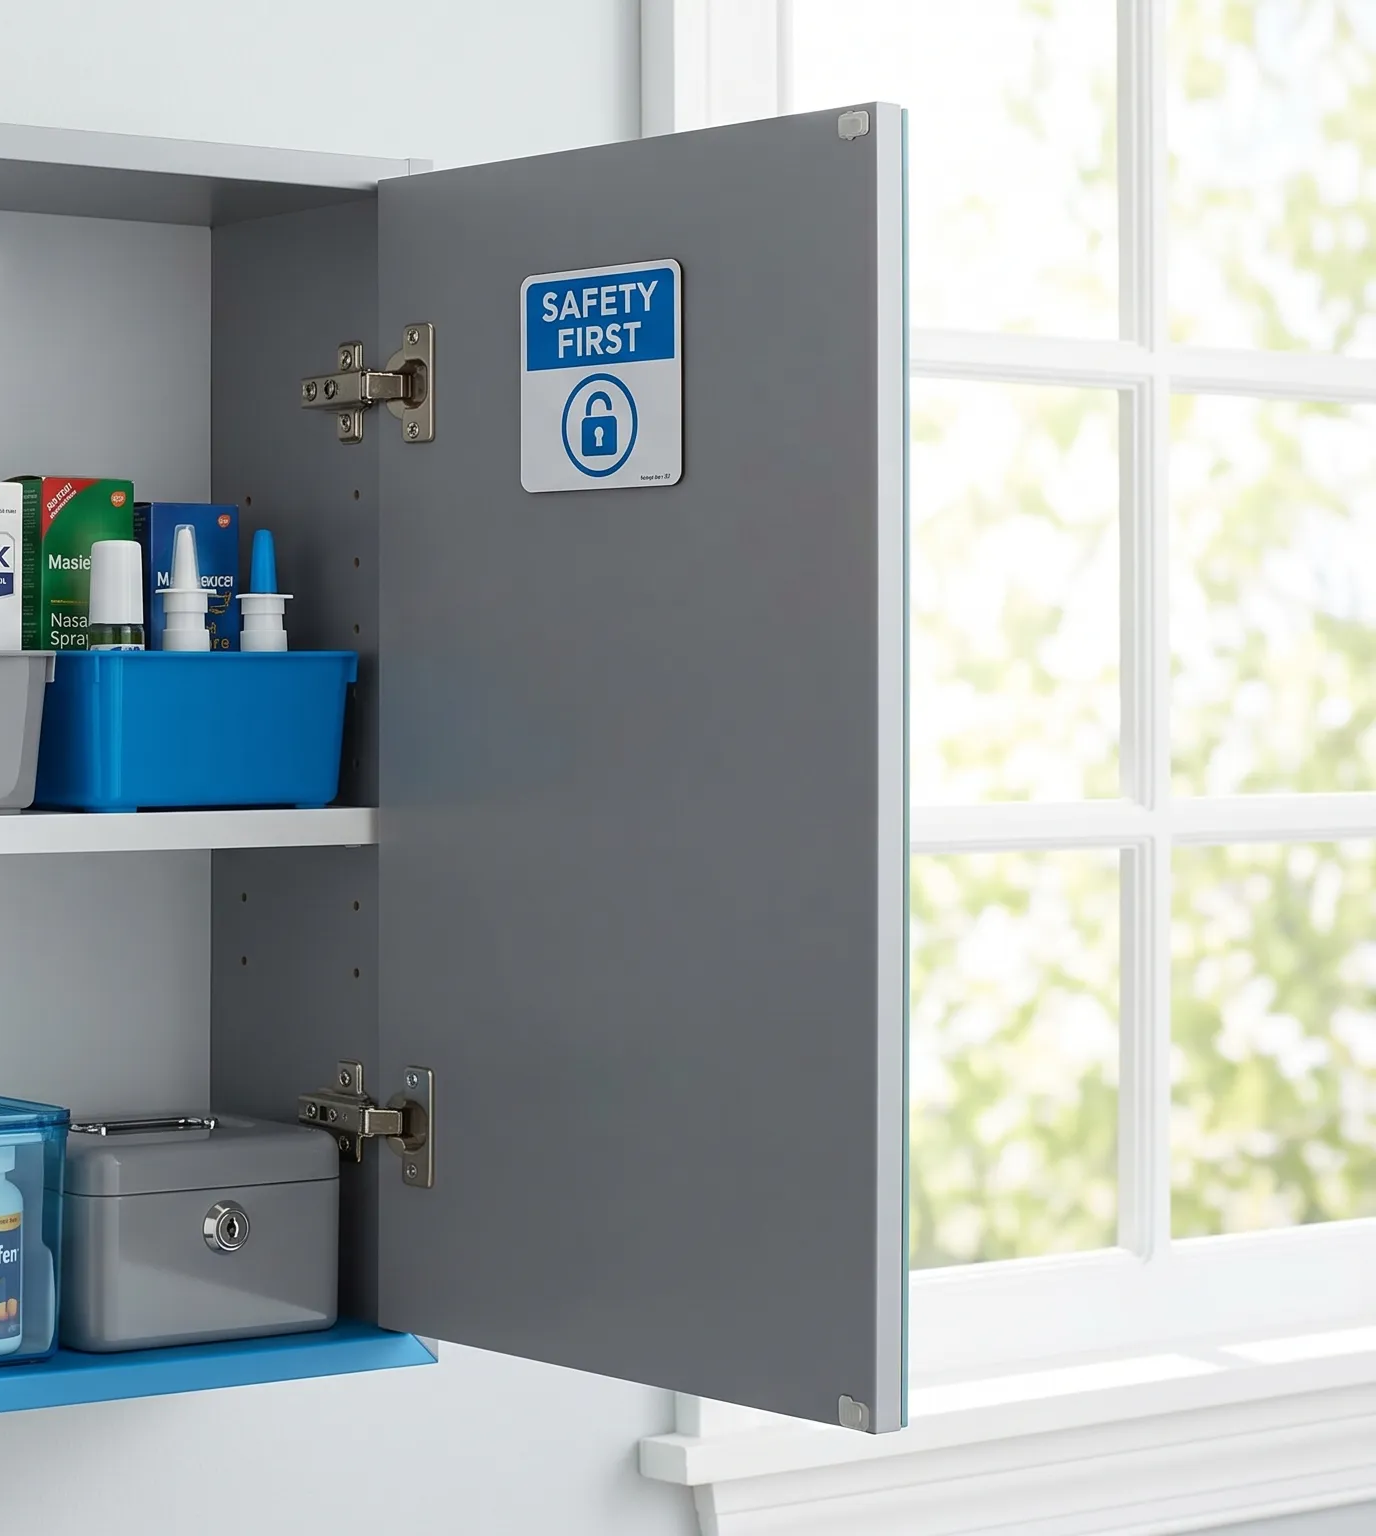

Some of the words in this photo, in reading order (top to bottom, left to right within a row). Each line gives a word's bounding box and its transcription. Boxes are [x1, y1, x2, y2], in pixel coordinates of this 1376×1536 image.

[542, 280, 658, 323] SAFETY
[558, 321, 642, 359] FIRST
[49, 553, 92, 570] Masie
[51, 612, 89, 628] Nasa
[50, 630, 88, 650] Spra
